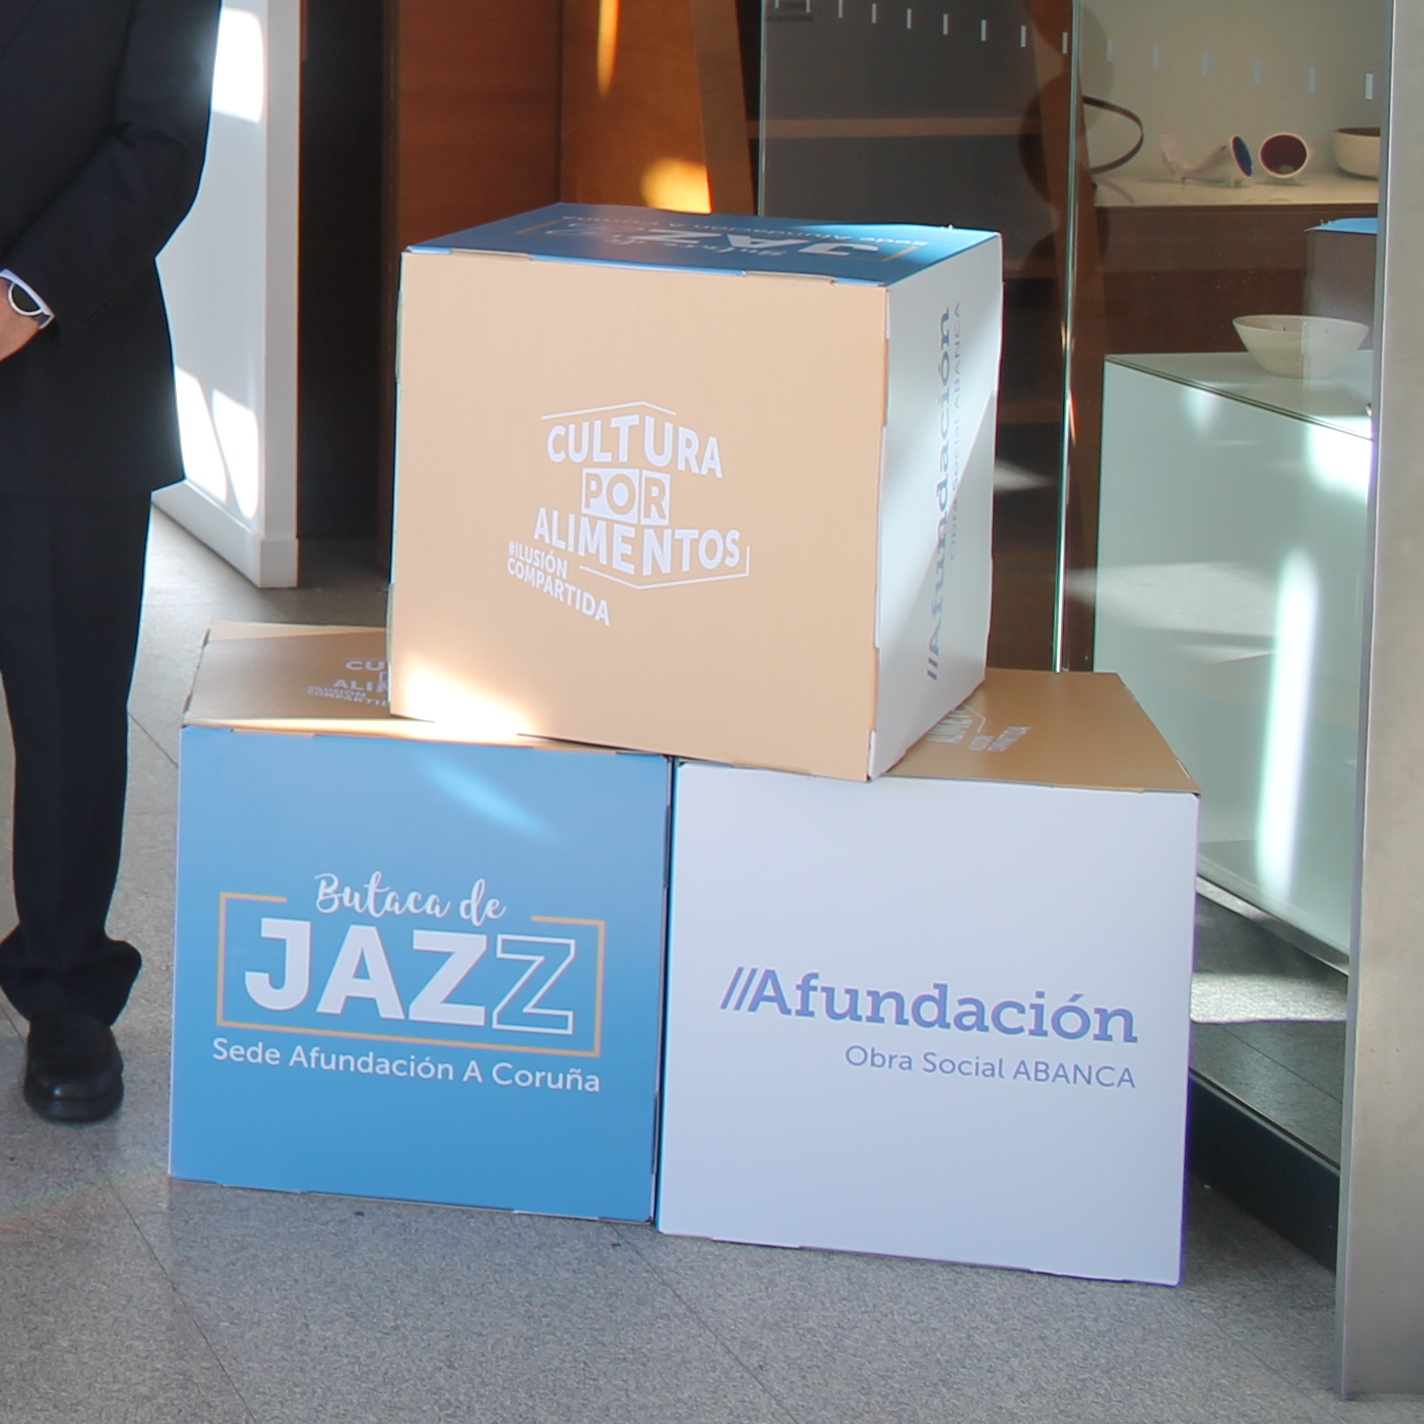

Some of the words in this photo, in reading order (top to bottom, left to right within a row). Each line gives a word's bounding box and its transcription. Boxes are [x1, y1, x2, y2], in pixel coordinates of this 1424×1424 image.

[546, 414, 724, 479] CULTURA
[582, 467, 670, 526] POR
[507, 540, 568, 580] #ILUSIÓN
[533, 508, 741, 576] ALIMENTOS
[506, 557, 611, 626] COMPARTIDA
[314, 871, 450, 920] Butaca
[457, 878, 507, 927] de
[244, 917, 576, 1035] JAZZ
[212, 1037, 281, 1067] Sede
[288, 1043, 454, 1082] Afundación
[462, 1059, 484, 1084] A
[491, 1061, 601, 1094] Coruña
[844, 1045, 914, 1073] Obra
[922, 1051, 1005, 1080] Social
[1012, 1060, 1137, 1089] ABANCA
